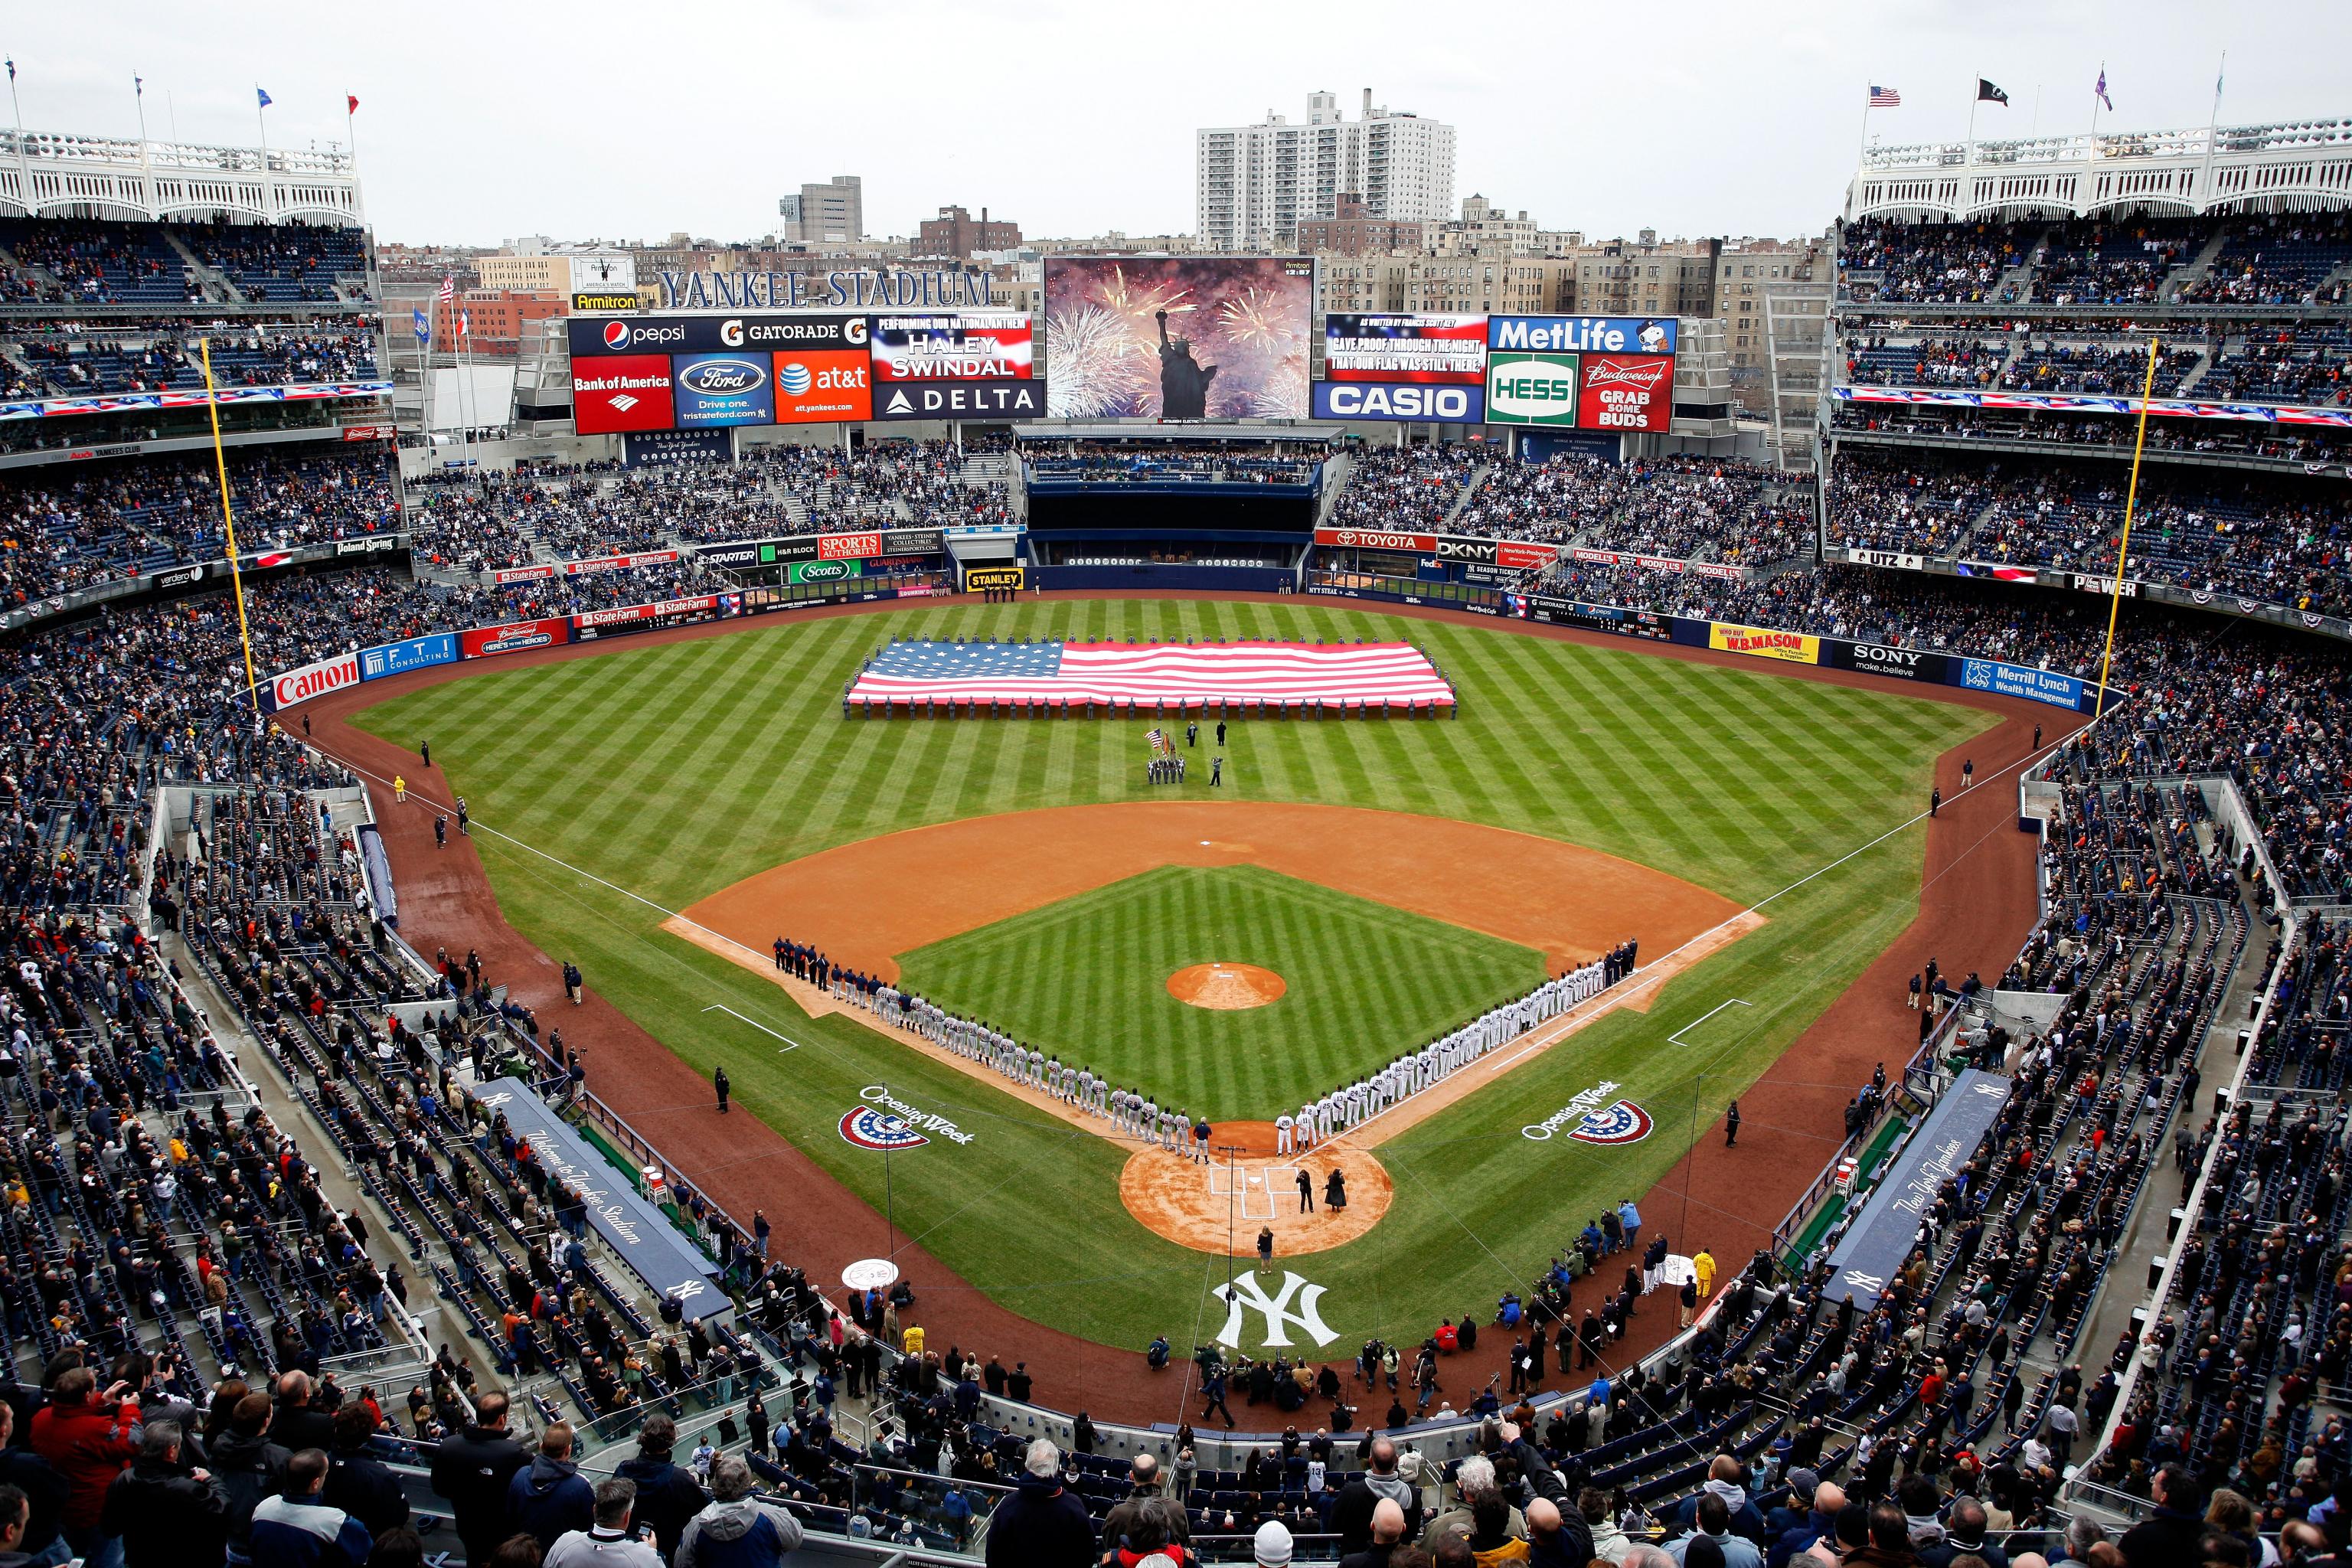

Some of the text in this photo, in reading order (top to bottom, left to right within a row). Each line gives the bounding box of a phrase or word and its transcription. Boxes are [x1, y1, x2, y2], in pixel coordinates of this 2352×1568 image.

[656, 271, 992, 308] YANKEE STADIUM
[577, 294, 635, 309] Armitron
[878, 318, 1026, 331] PERFORMING OUR NATIONAL ANTHEM
[633, 325, 684, 345] pepsi
[750, 325, 838, 340] GATORADE
[1498, 318, 1625, 351] MetLife
[1333, 338, 1481, 354] GAVE PROOF THROUGH THE NIGHT
[1331, 357, 1481, 374] THAT OUR FLAG WAS STILL THERE;
[700, 368, 745, 388] Ford
[817, 366, 867, 389] at&t
[1586, 367, 1663, 381] Budweiser
[575, 374, 669, 391] Bank of America
[1496, 378, 1568, 400] HESS
[924, 387, 1034, 411] DELTA
[1329, 387, 1467, 417] CASIO
[1600, 390, 1650, 404] GRAB
[698, 401, 726, 410] Drive
[795, 403, 853, 413] att.yankees.com
[1608, 404, 1641, 413] SOME
[683, 411, 756, 420] tristateford.com
[1599, 413, 1648, 427] BUDS
[96, 447, 123, 457] YANKEES
[125, 446, 141, 454] CLUB
[338, 539, 392, 555] Poland Spring
[822, 535, 877, 550] SPORTS
[1359, 534, 1416, 548] TOYOTA
[710, 551, 754, 563] STARTER
[1438, 543, 1495, 559] DKNY
[1576, 551, 1613, 562] MODELL'S
[870, 556, 924, 567] GUARDSMARK
[1421, 559, 1442, 568] FedEx
[1640, 560, 1680, 570] MODELL'S
[1870, 553, 1898, 566] UTZ
[161, 573, 189, 584] verdero
[807, 566, 841, 577] Scotts
[1698, 565, 1740, 577] MODELL'S
[972, 575, 1017, 585] STANLEY
[903, 588, 927, 596] DUNKIN'
[486, 636, 547, 651] HERE'S HEROES
[390, 652, 449, 669] CONSULTING
[1854, 645, 1922, 665] SONY
[1856, 661, 1914, 677] make.believe
[276, 660, 358, 704] Canon
[1997, 667, 2069, 693] Merrill Lynch
[1996, 681, 2076, 707] Wealth Management
[2082, 689, 2092, 697] 314
[859, 1086, 975, 1145] Opening Week
[1522, 1081, 1621, 1140] Opening Week
[1924, 1138, 1962, 1176] Yankees
[527, 1130, 643, 1245] Welcome to Yankee Stadium
